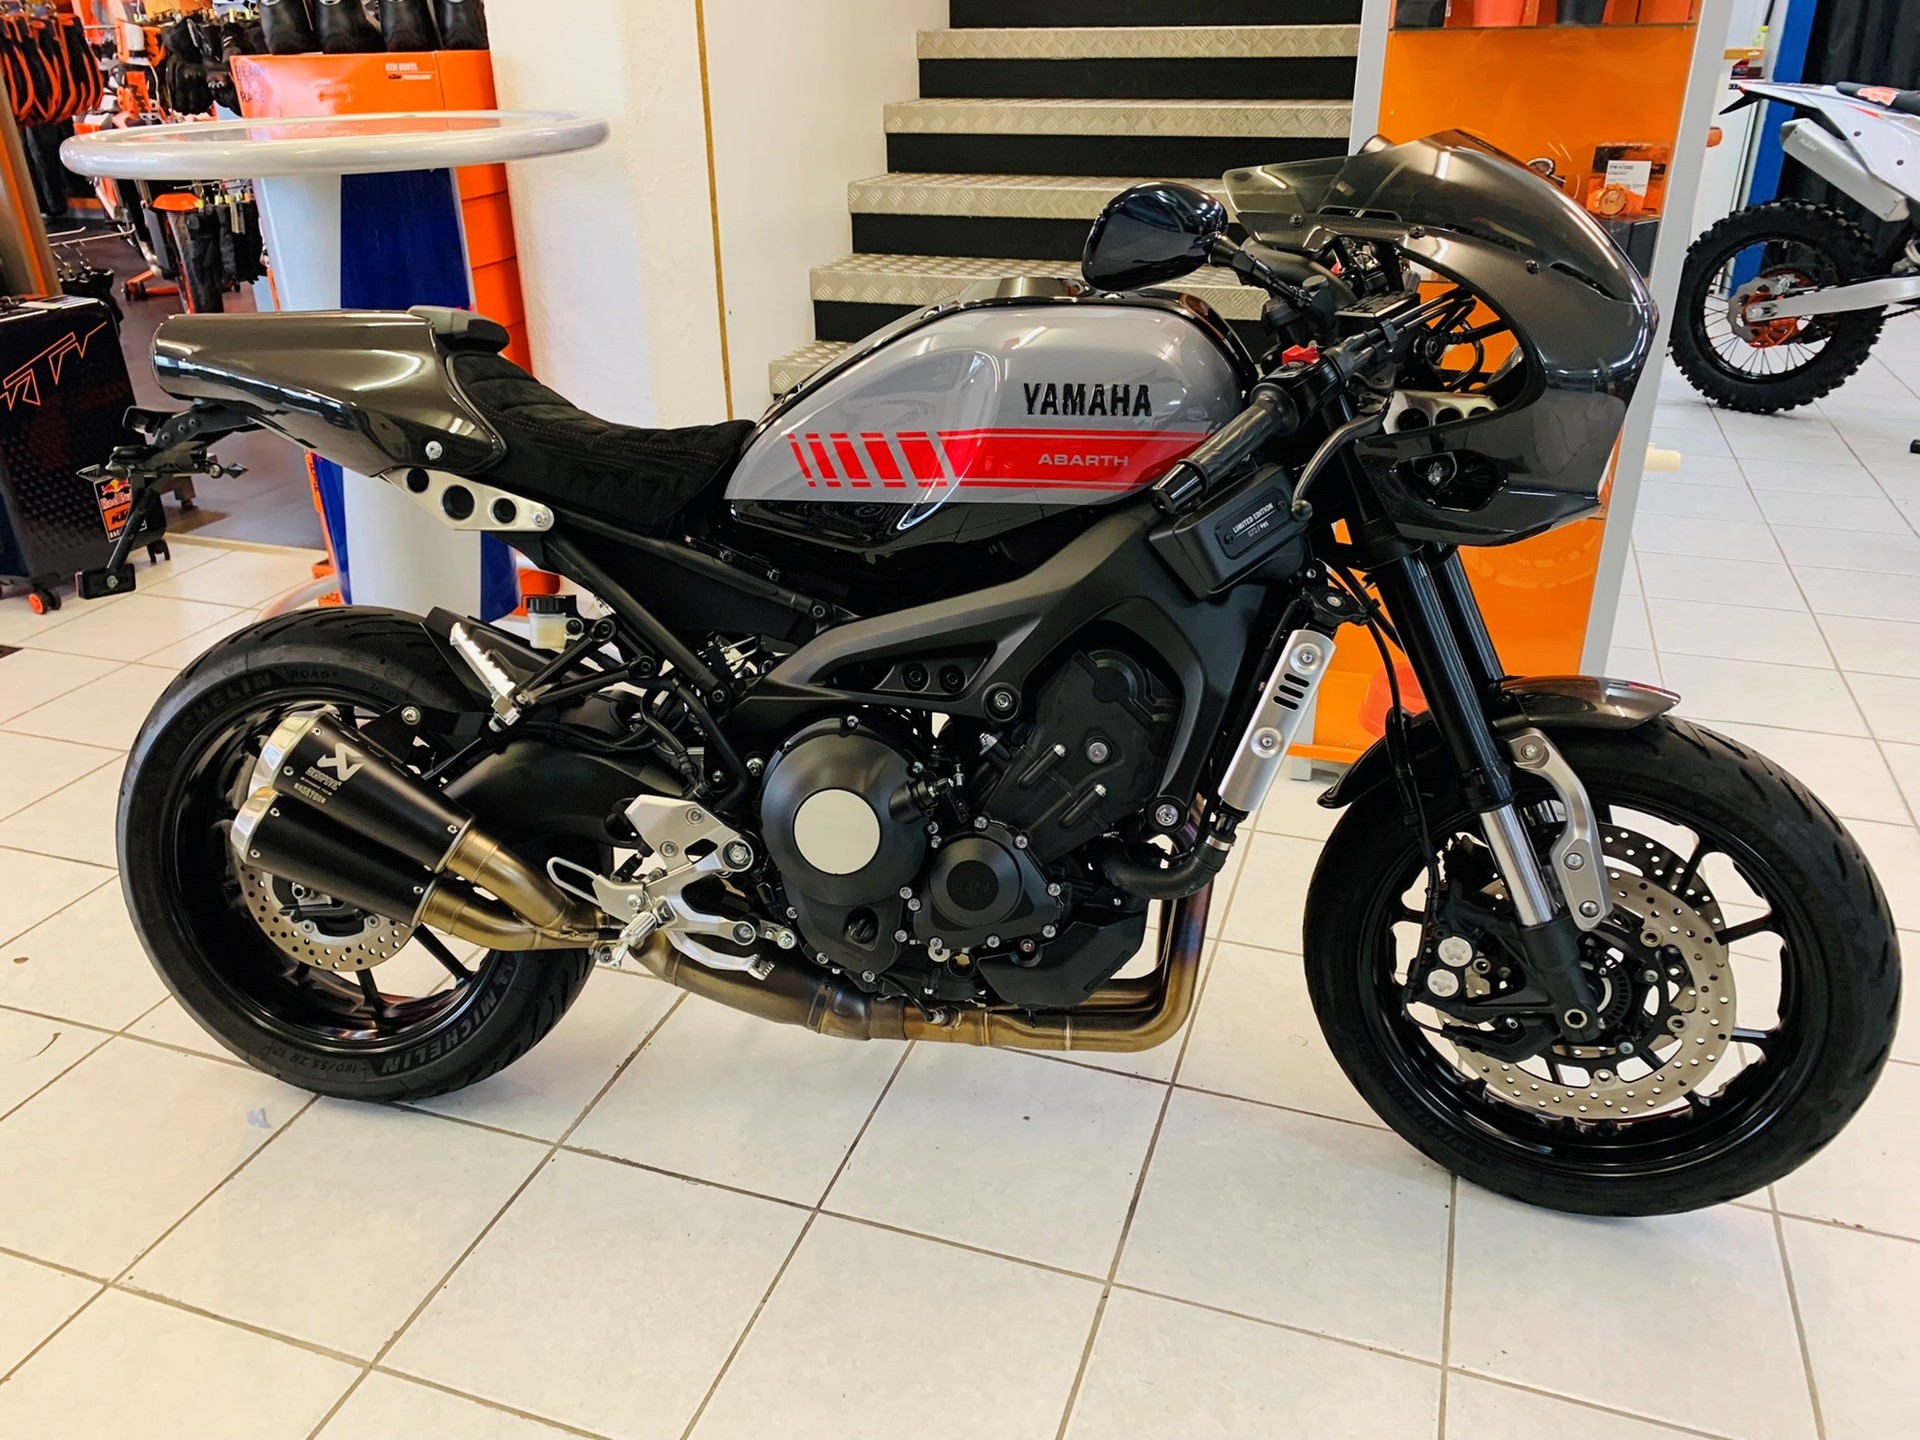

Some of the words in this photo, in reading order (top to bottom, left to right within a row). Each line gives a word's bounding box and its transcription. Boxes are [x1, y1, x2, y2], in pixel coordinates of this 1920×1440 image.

[1023, 383, 1152, 416] YAMAHA
[1038, 453, 1129, 466] ABARTH
[1232, 516, 1254, 534] LIMITED
[1252, 502, 1274, 520] EDITION
[381, 989, 498, 1075] MICHELIN
